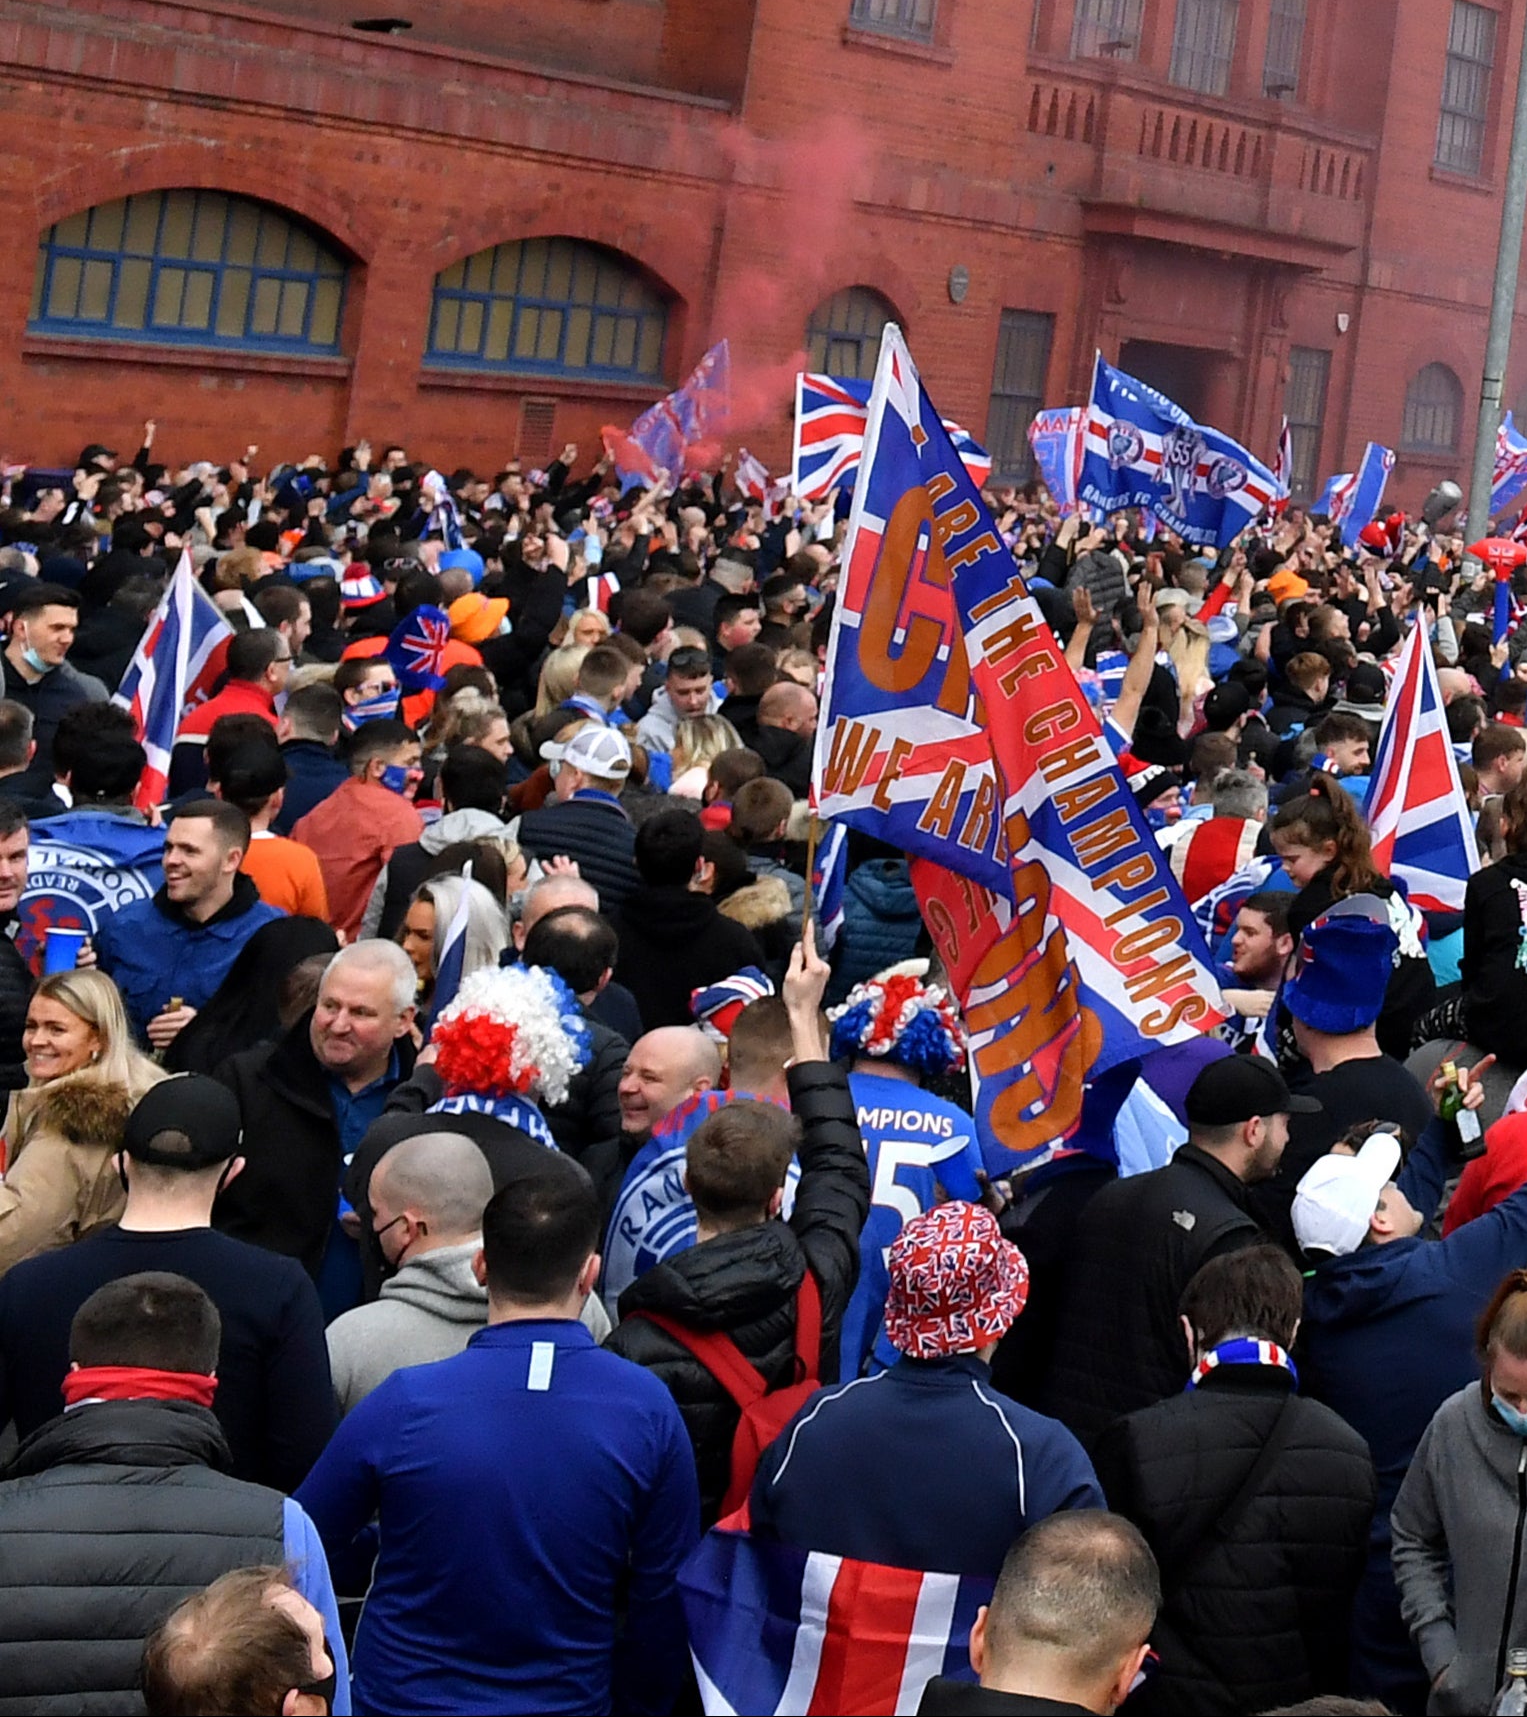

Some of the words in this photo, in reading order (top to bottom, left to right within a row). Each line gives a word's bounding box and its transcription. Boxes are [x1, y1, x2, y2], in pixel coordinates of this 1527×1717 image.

[1171, 440, 1192, 467] 55
[1082, 483, 1130, 512] RANGERS
[823, 716, 914, 813] WE
[968, 575, 1059, 701] THE
[1021, 697, 1208, 1040] CHAMPIONS
